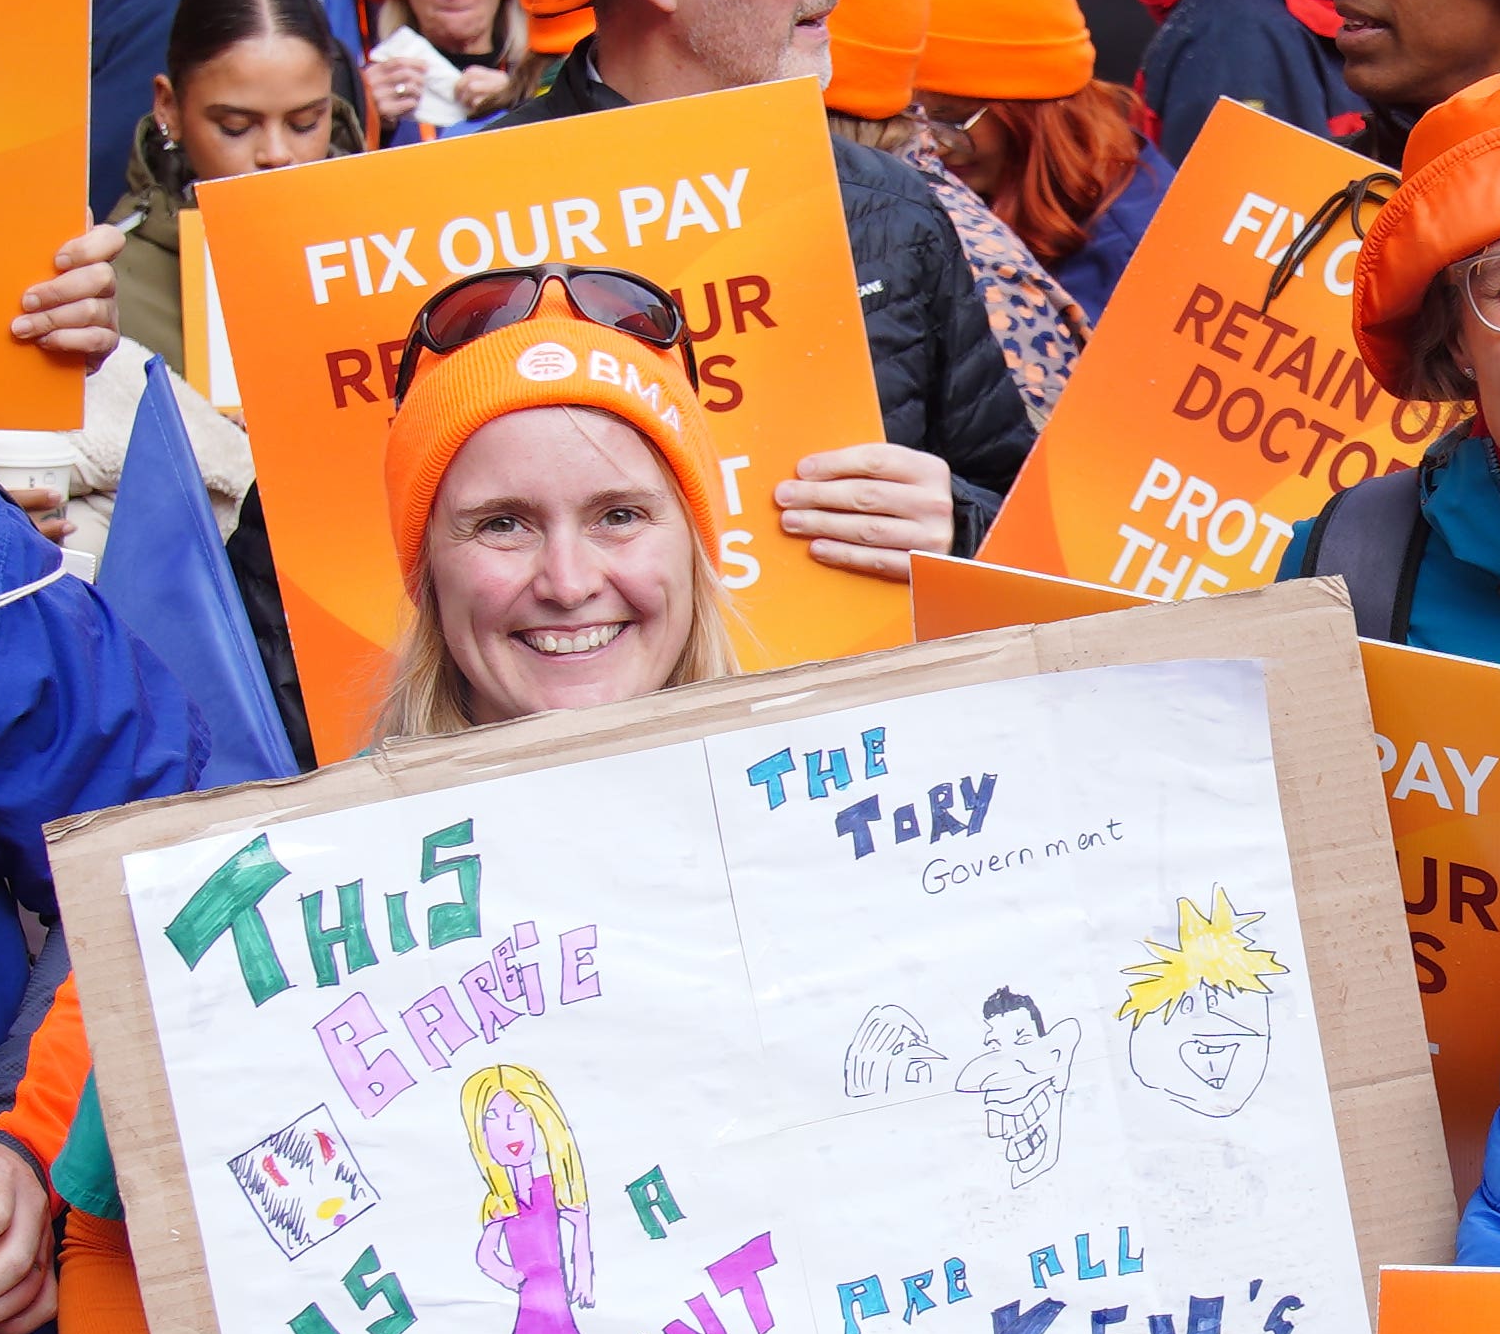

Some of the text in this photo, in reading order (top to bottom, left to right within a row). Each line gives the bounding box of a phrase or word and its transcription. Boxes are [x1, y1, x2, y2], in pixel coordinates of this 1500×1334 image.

[304, 167, 749, 305] FIX OUR PAY
[1221, 191, 1312, 281] FIX
[680, 274, 779, 347] UR
[589, 351, 683, 435] BMA
[1174, 283, 1384, 424] RETAIN
[1175, 366, 1408, 495] DOCTO
[1130, 459, 1296, 577] PROT
[1108, 523, 1230, 601] THE
[748, 728, 889, 810] THE
[1376, 735, 1499, 817] PAY
[837, 772, 998, 859] TORY
[923, 819, 1125, 895] Government
[626, 1165, 684, 1240] A
[1031, 1225, 1144, 1289] ALL
